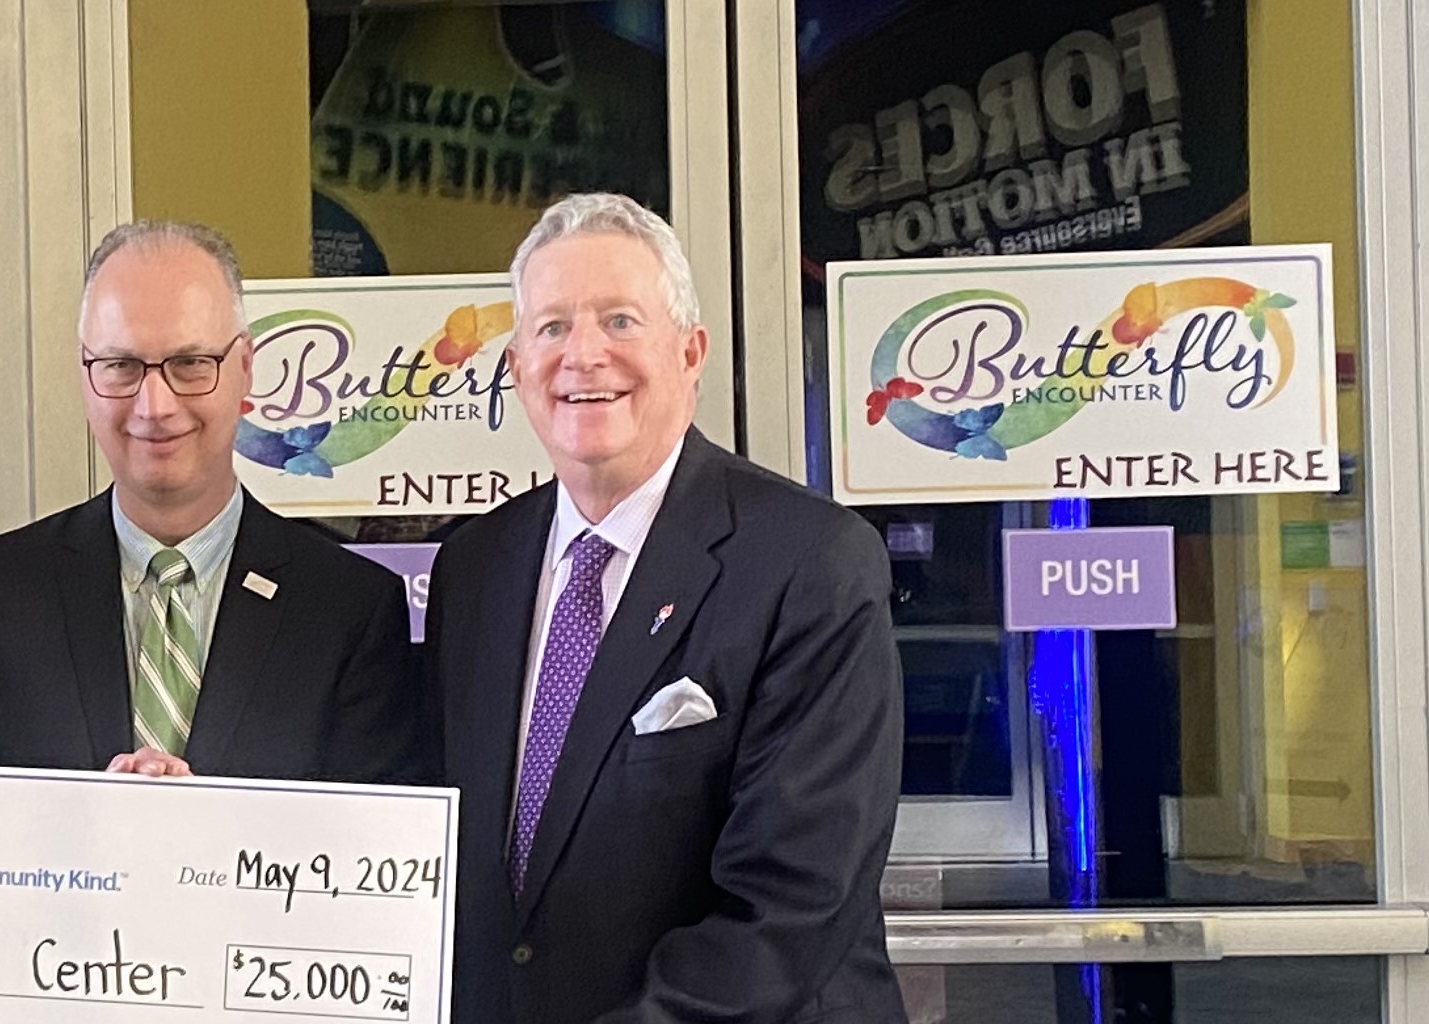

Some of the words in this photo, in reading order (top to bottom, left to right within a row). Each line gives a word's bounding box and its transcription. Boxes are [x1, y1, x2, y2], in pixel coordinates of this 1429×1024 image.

[908, 303, 1273, 412] Butterfly
[1012, 383, 1164, 405] ENCOUNTER
[339, 403, 482, 423] ENCOUNTER
[1054, 453, 1204, 490] ENTER
[1214, 449, 1329, 486] HERE
[377, 471, 513, 507] ENTER
[1041, 559, 1140, 596] PUSH
[178, 866, 228, 887] Date
[236, 849, 301, 913] May
[310, 854, 339, 898] 9,
[357, 856, 442, 899] 2024
[32, 929, 186, 1000] Center
